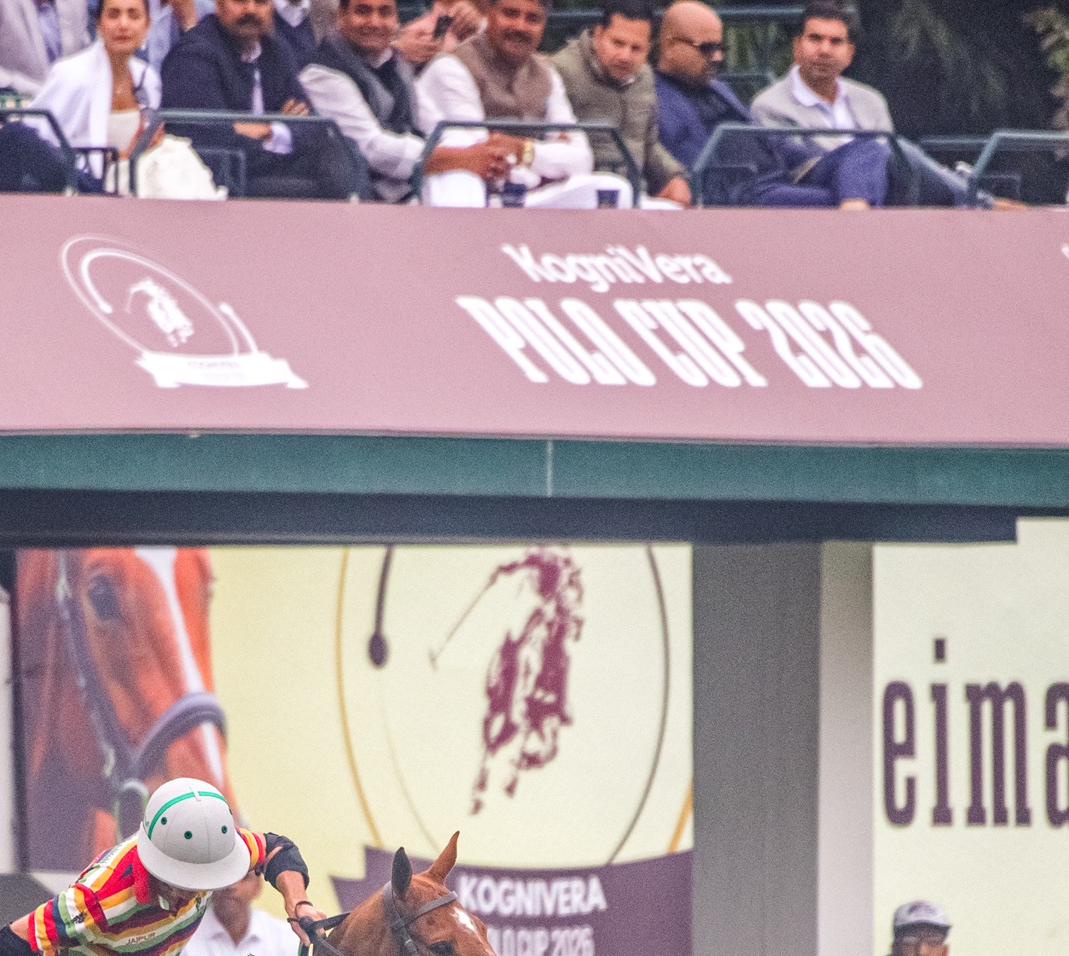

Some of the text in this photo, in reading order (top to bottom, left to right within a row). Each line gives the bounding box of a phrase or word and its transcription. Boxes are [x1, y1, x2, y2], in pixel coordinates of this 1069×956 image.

[500, 244, 733, 293] KogniVera
[455, 295, 923, 389] POLO CUP 2026
[459, 874, 608, 916] KOGNIVERA
